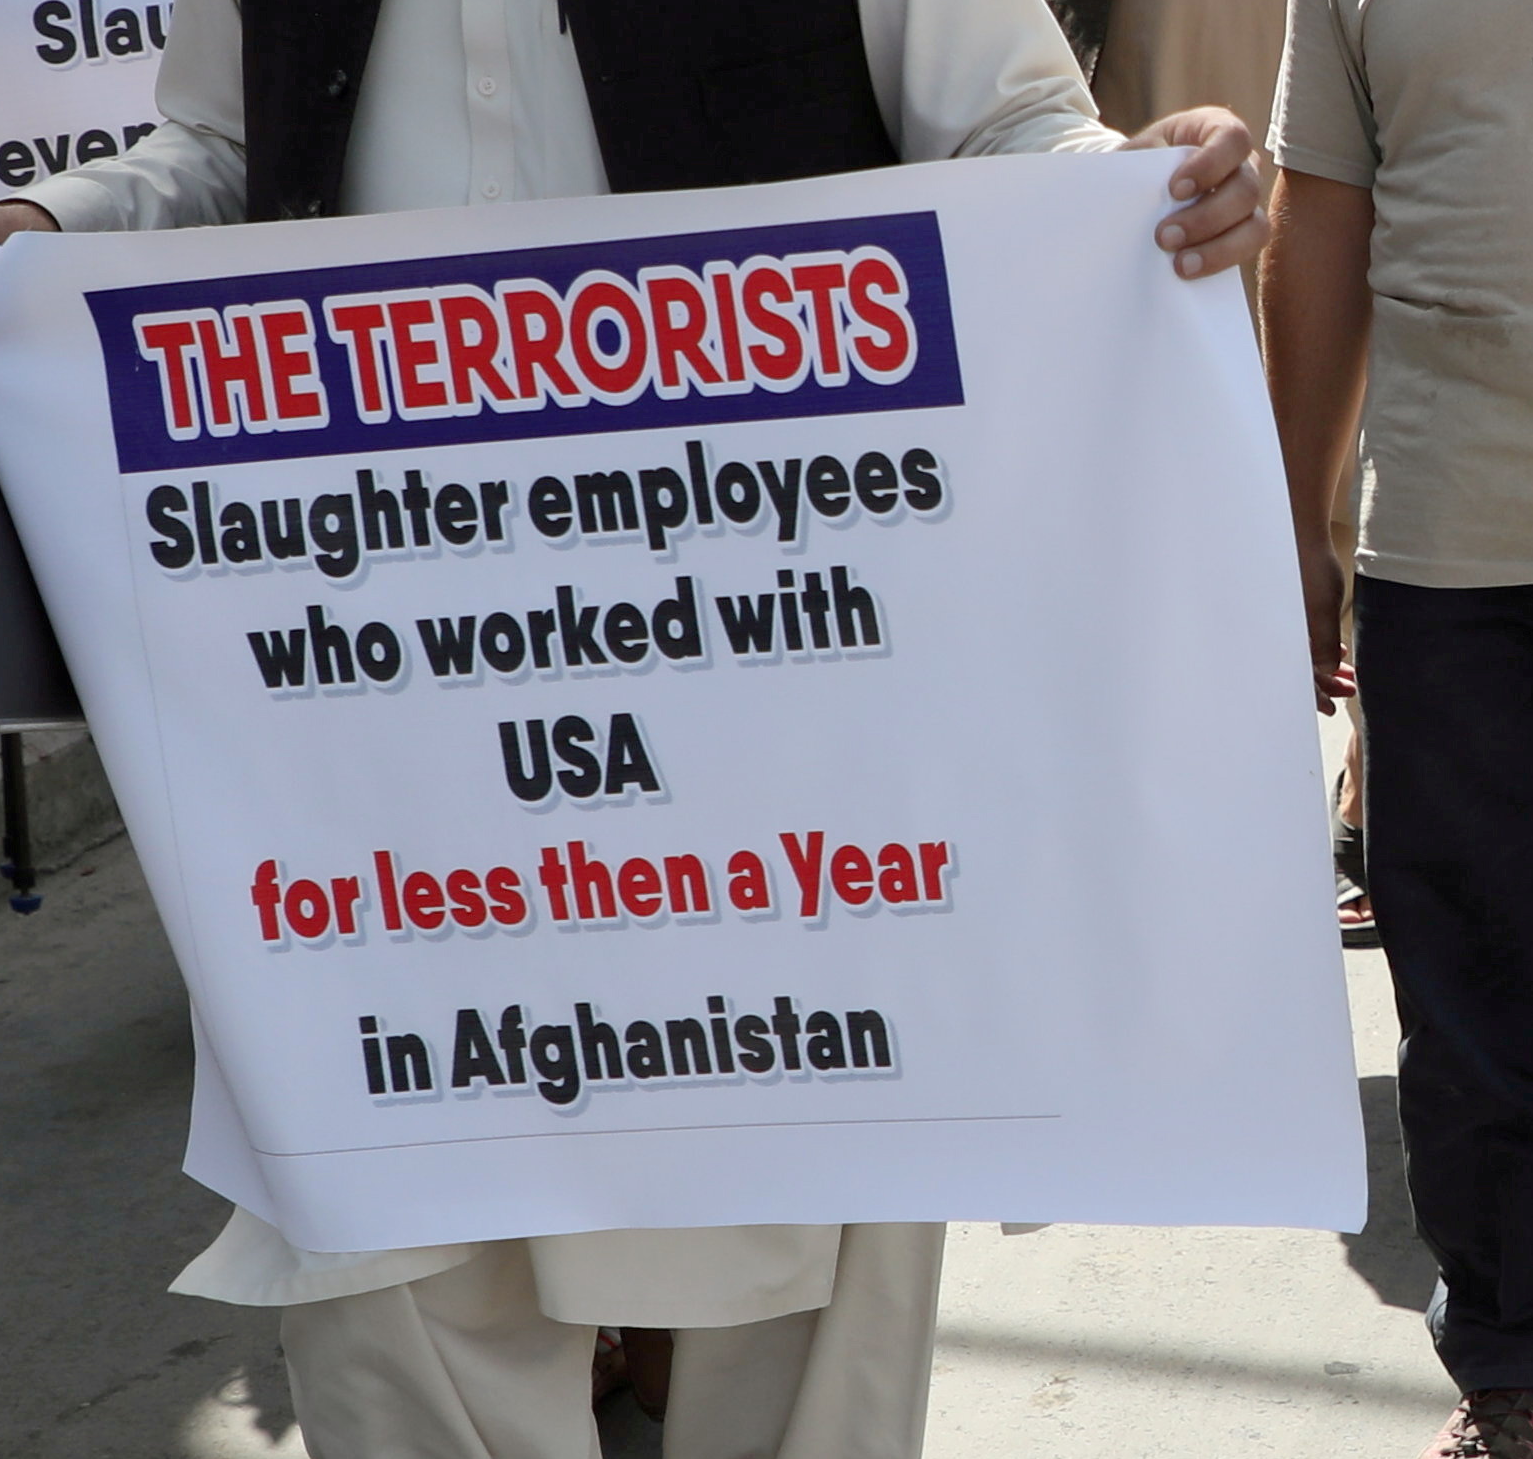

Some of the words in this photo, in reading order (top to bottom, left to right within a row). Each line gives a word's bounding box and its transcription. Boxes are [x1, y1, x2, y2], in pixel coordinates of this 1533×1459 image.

[141, 312, 322, 429] THE
[332, 258, 910, 412] TERRORISTS
[146, 470, 509, 579] Slaughter
[528, 441, 942, 551] employees
[247, 605, 401, 688] who
[415, 576, 702, 677] worked
[714, 566, 881, 655] with
[499, 713, 661, 802] USA
[251, 859, 359, 941] for
[373, 850, 527, 931] less
[538, 840, 711, 921] then
[728, 850, 770, 912] a
[779, 831, 949, 917] Year
[359, 1016, 433, 1095] in
[450, 996, 890, 1104] Afghanistan
